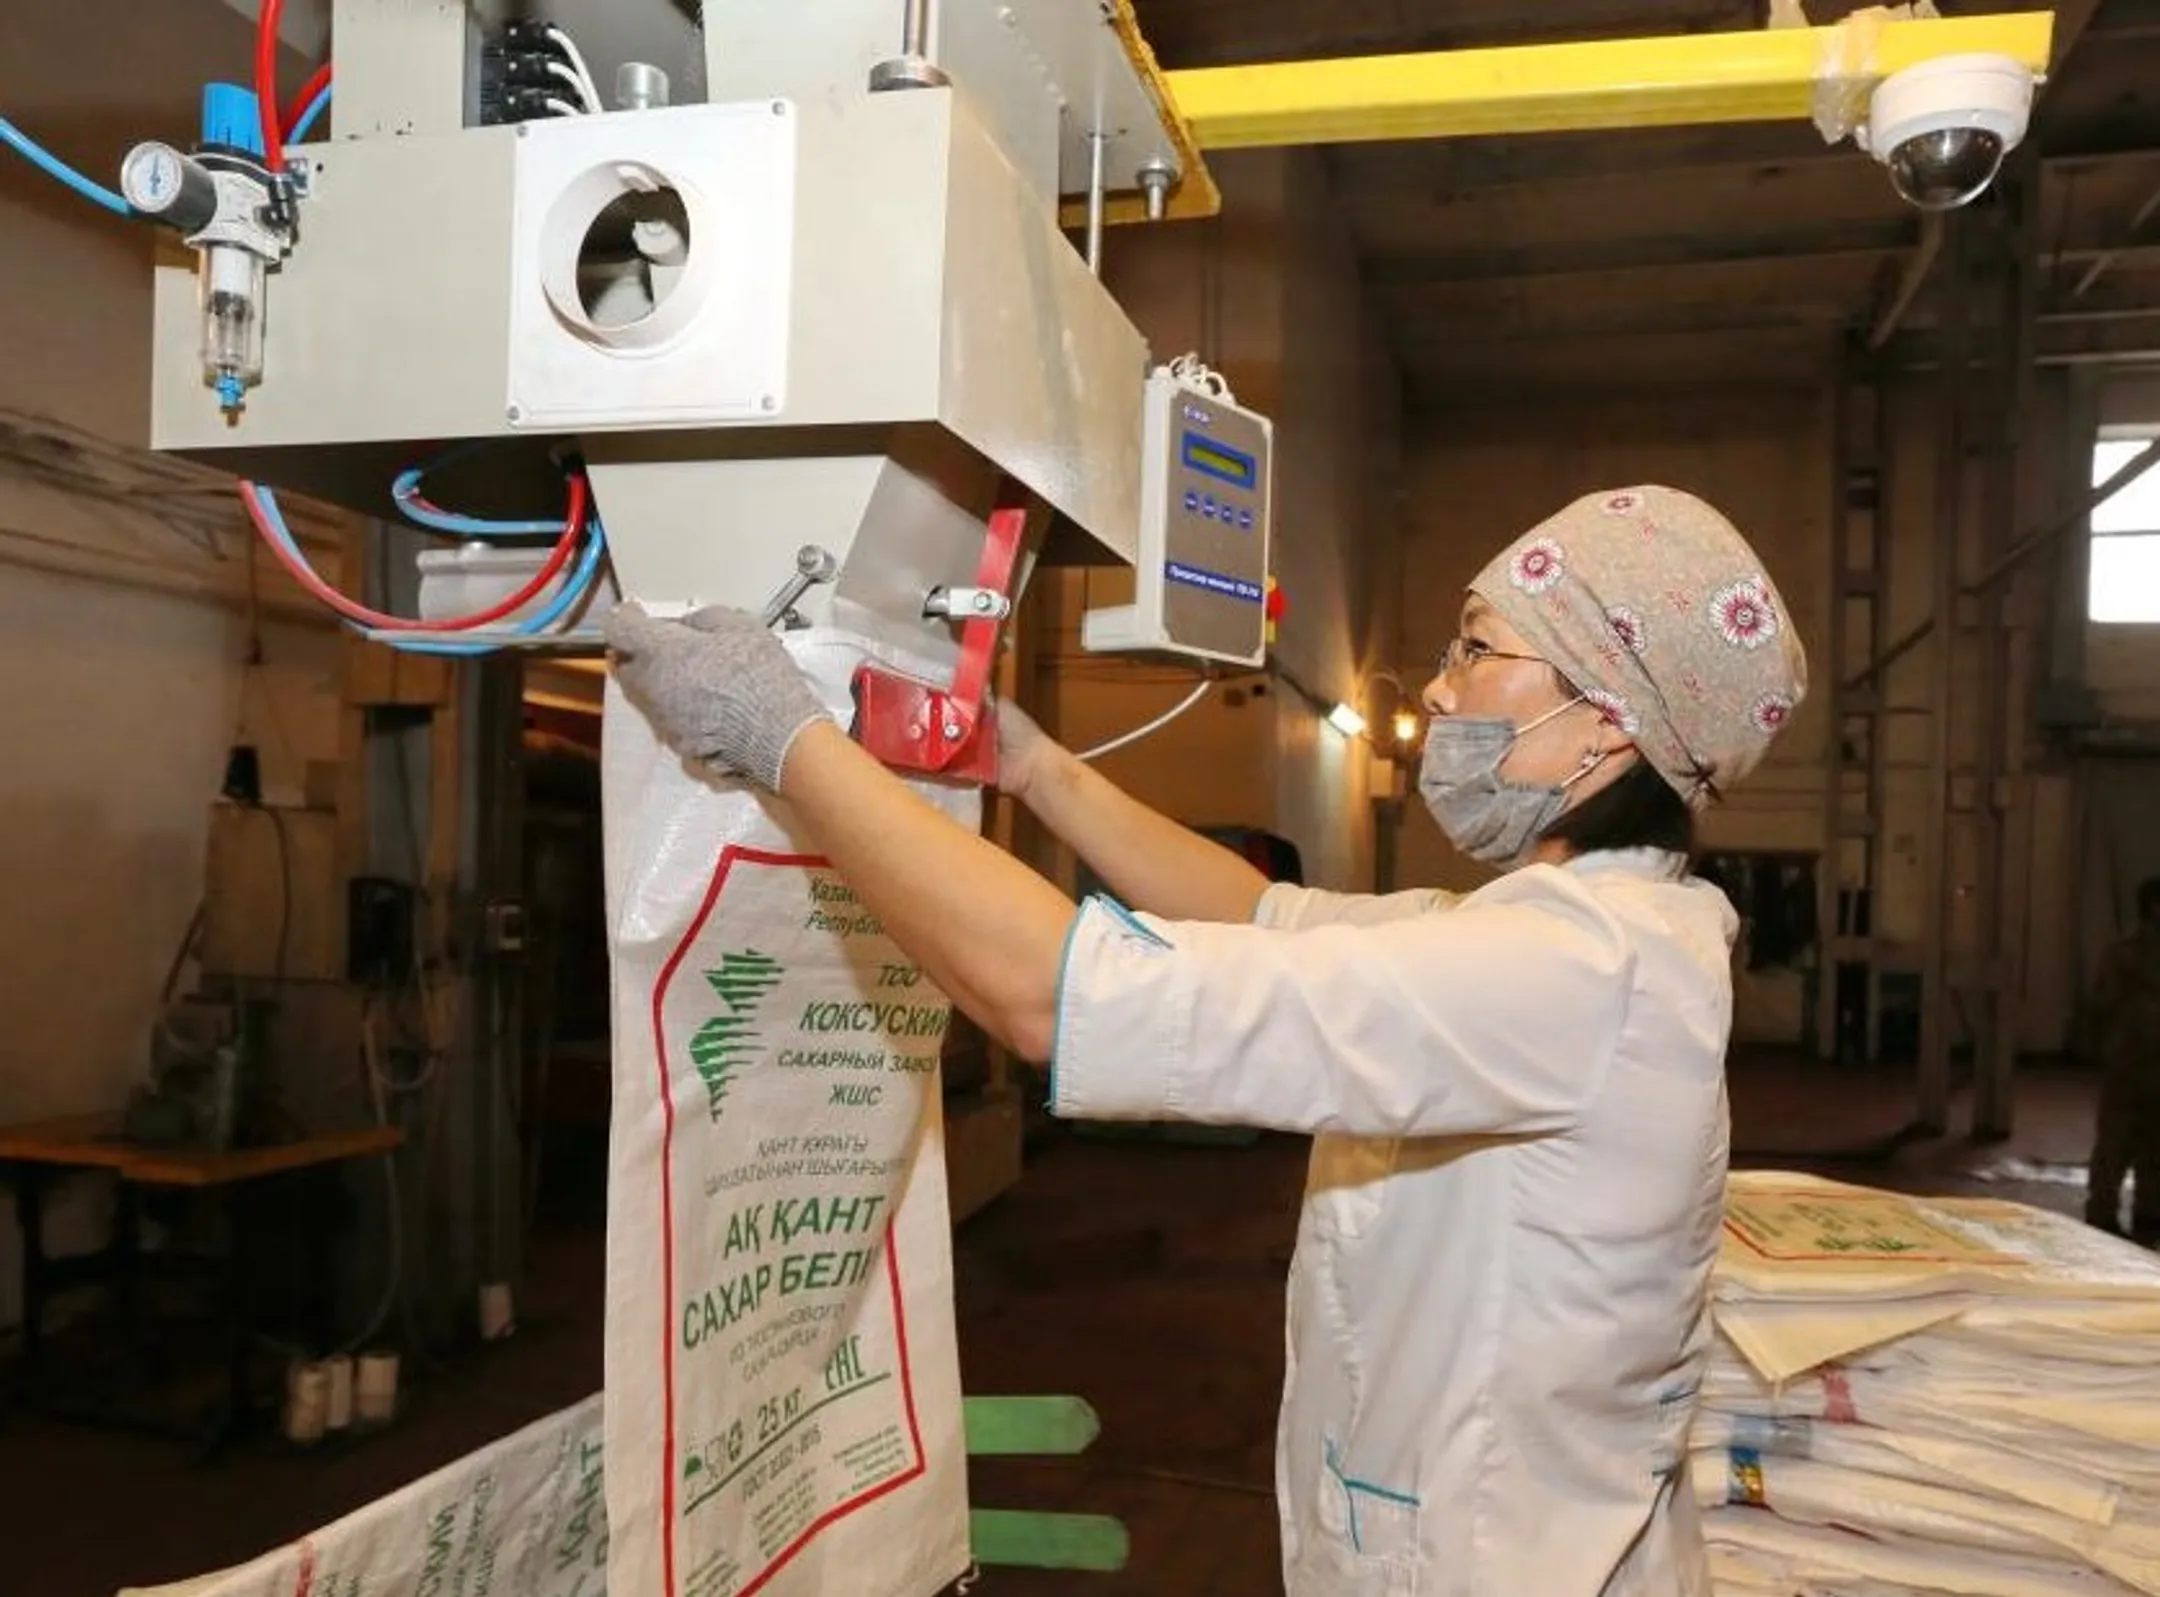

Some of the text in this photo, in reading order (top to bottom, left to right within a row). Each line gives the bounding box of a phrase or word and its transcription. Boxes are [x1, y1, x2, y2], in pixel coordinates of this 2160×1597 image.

[876, 964, 922, 987] ТОО
[777, 1050, 884, 1071] САХАРНЫЙ
[829, 1084, 883, 1106] ЖШС
[724, 1196, 885, 1260] АҚ ҚАНТ
[683, 1264, 771, 1350] САХАР
[757, 1396, 778, 1441] 25
